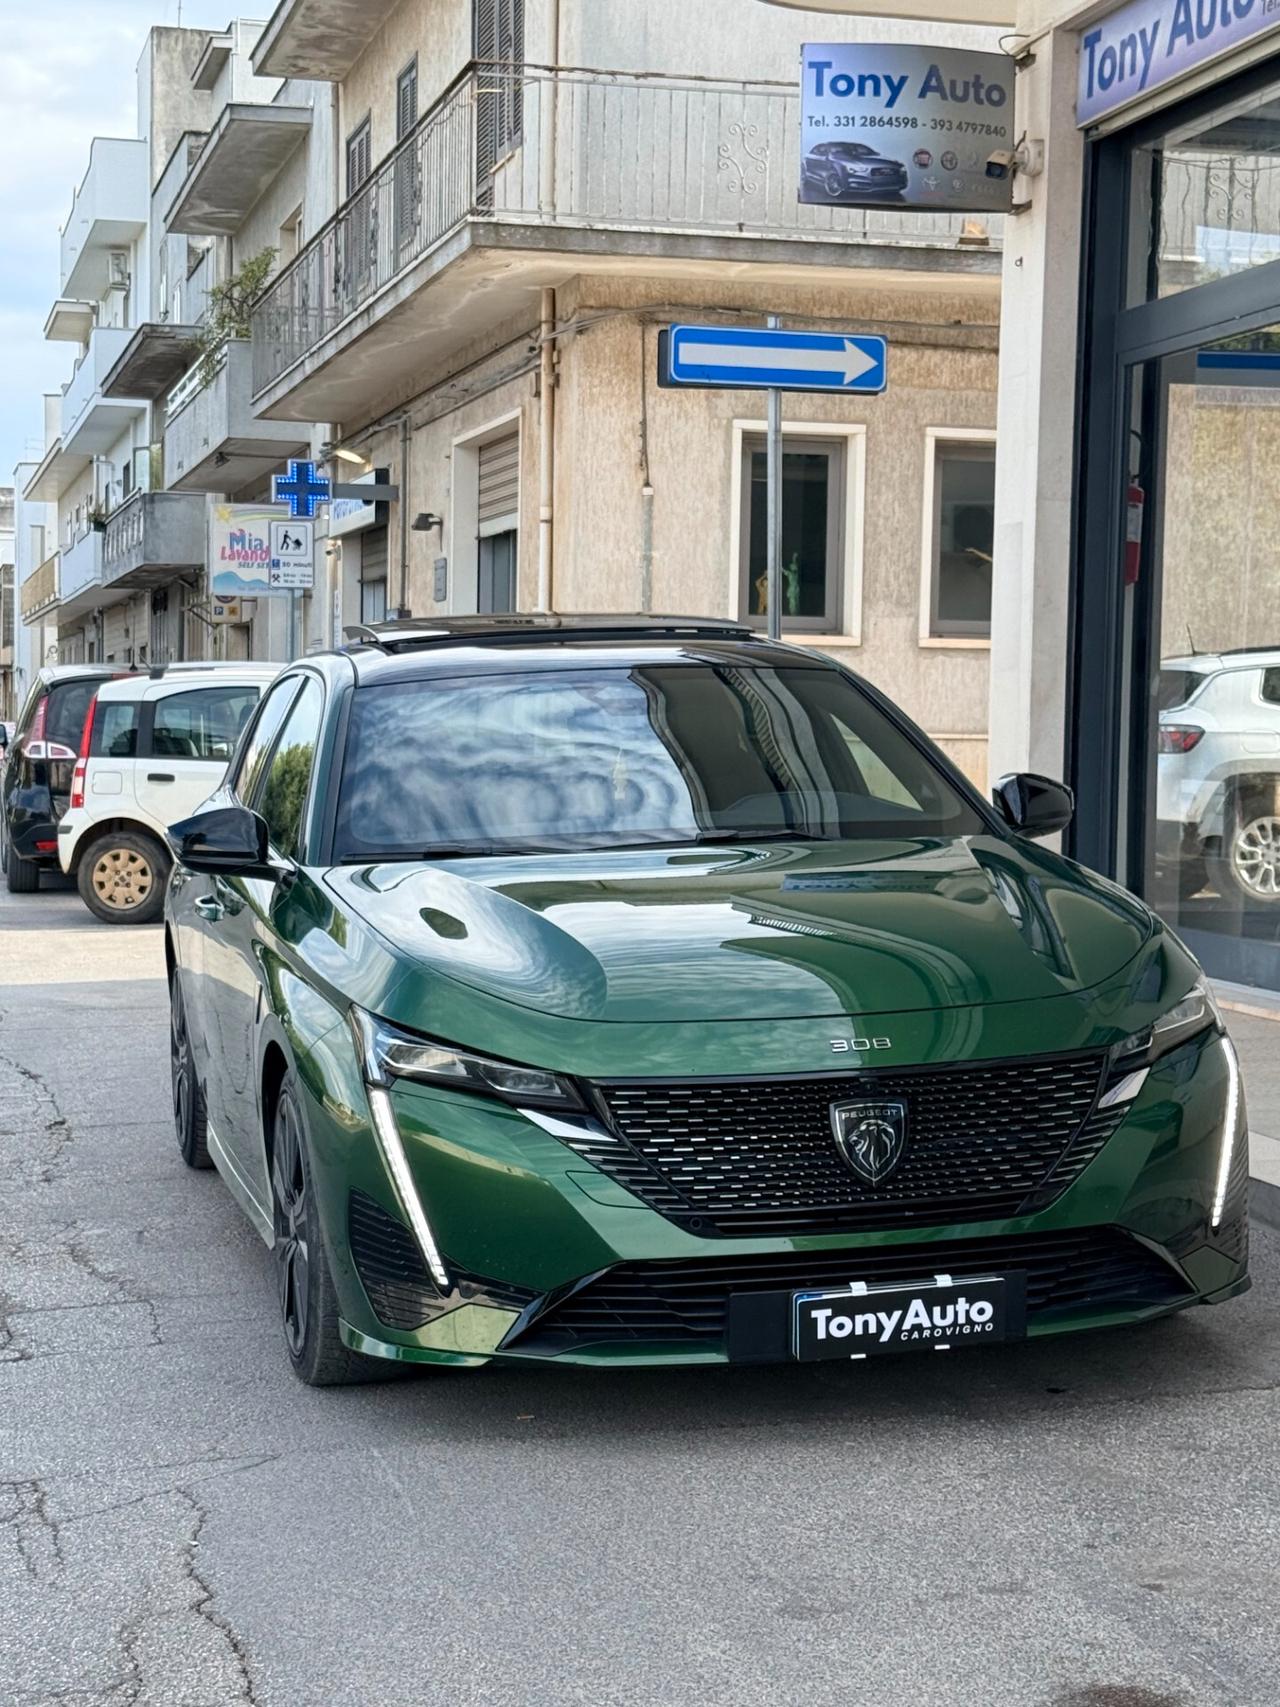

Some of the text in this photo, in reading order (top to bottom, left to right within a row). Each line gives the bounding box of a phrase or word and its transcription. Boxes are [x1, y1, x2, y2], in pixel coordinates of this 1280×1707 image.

[1084, 19, 1161, 98] Tony
[807, 61, 1007, 108] Tony Auto
[807, 115, 830, 128] Tel.
[833, 116, 856, 128] 331
[860, 115, 919, 129] 2864598
[930, 118, 953, 131] 393
[955, 121, 1007, 138] 4797840
[229, 528, 264, 550] Mia
[220, 545, 270, 561] Lavand
[830, 1038, 891, 1052] 308
[841, 1108, 898, 1120] PEUGEOT
[900, 1323, 994, 1341] CAROVIGNO
